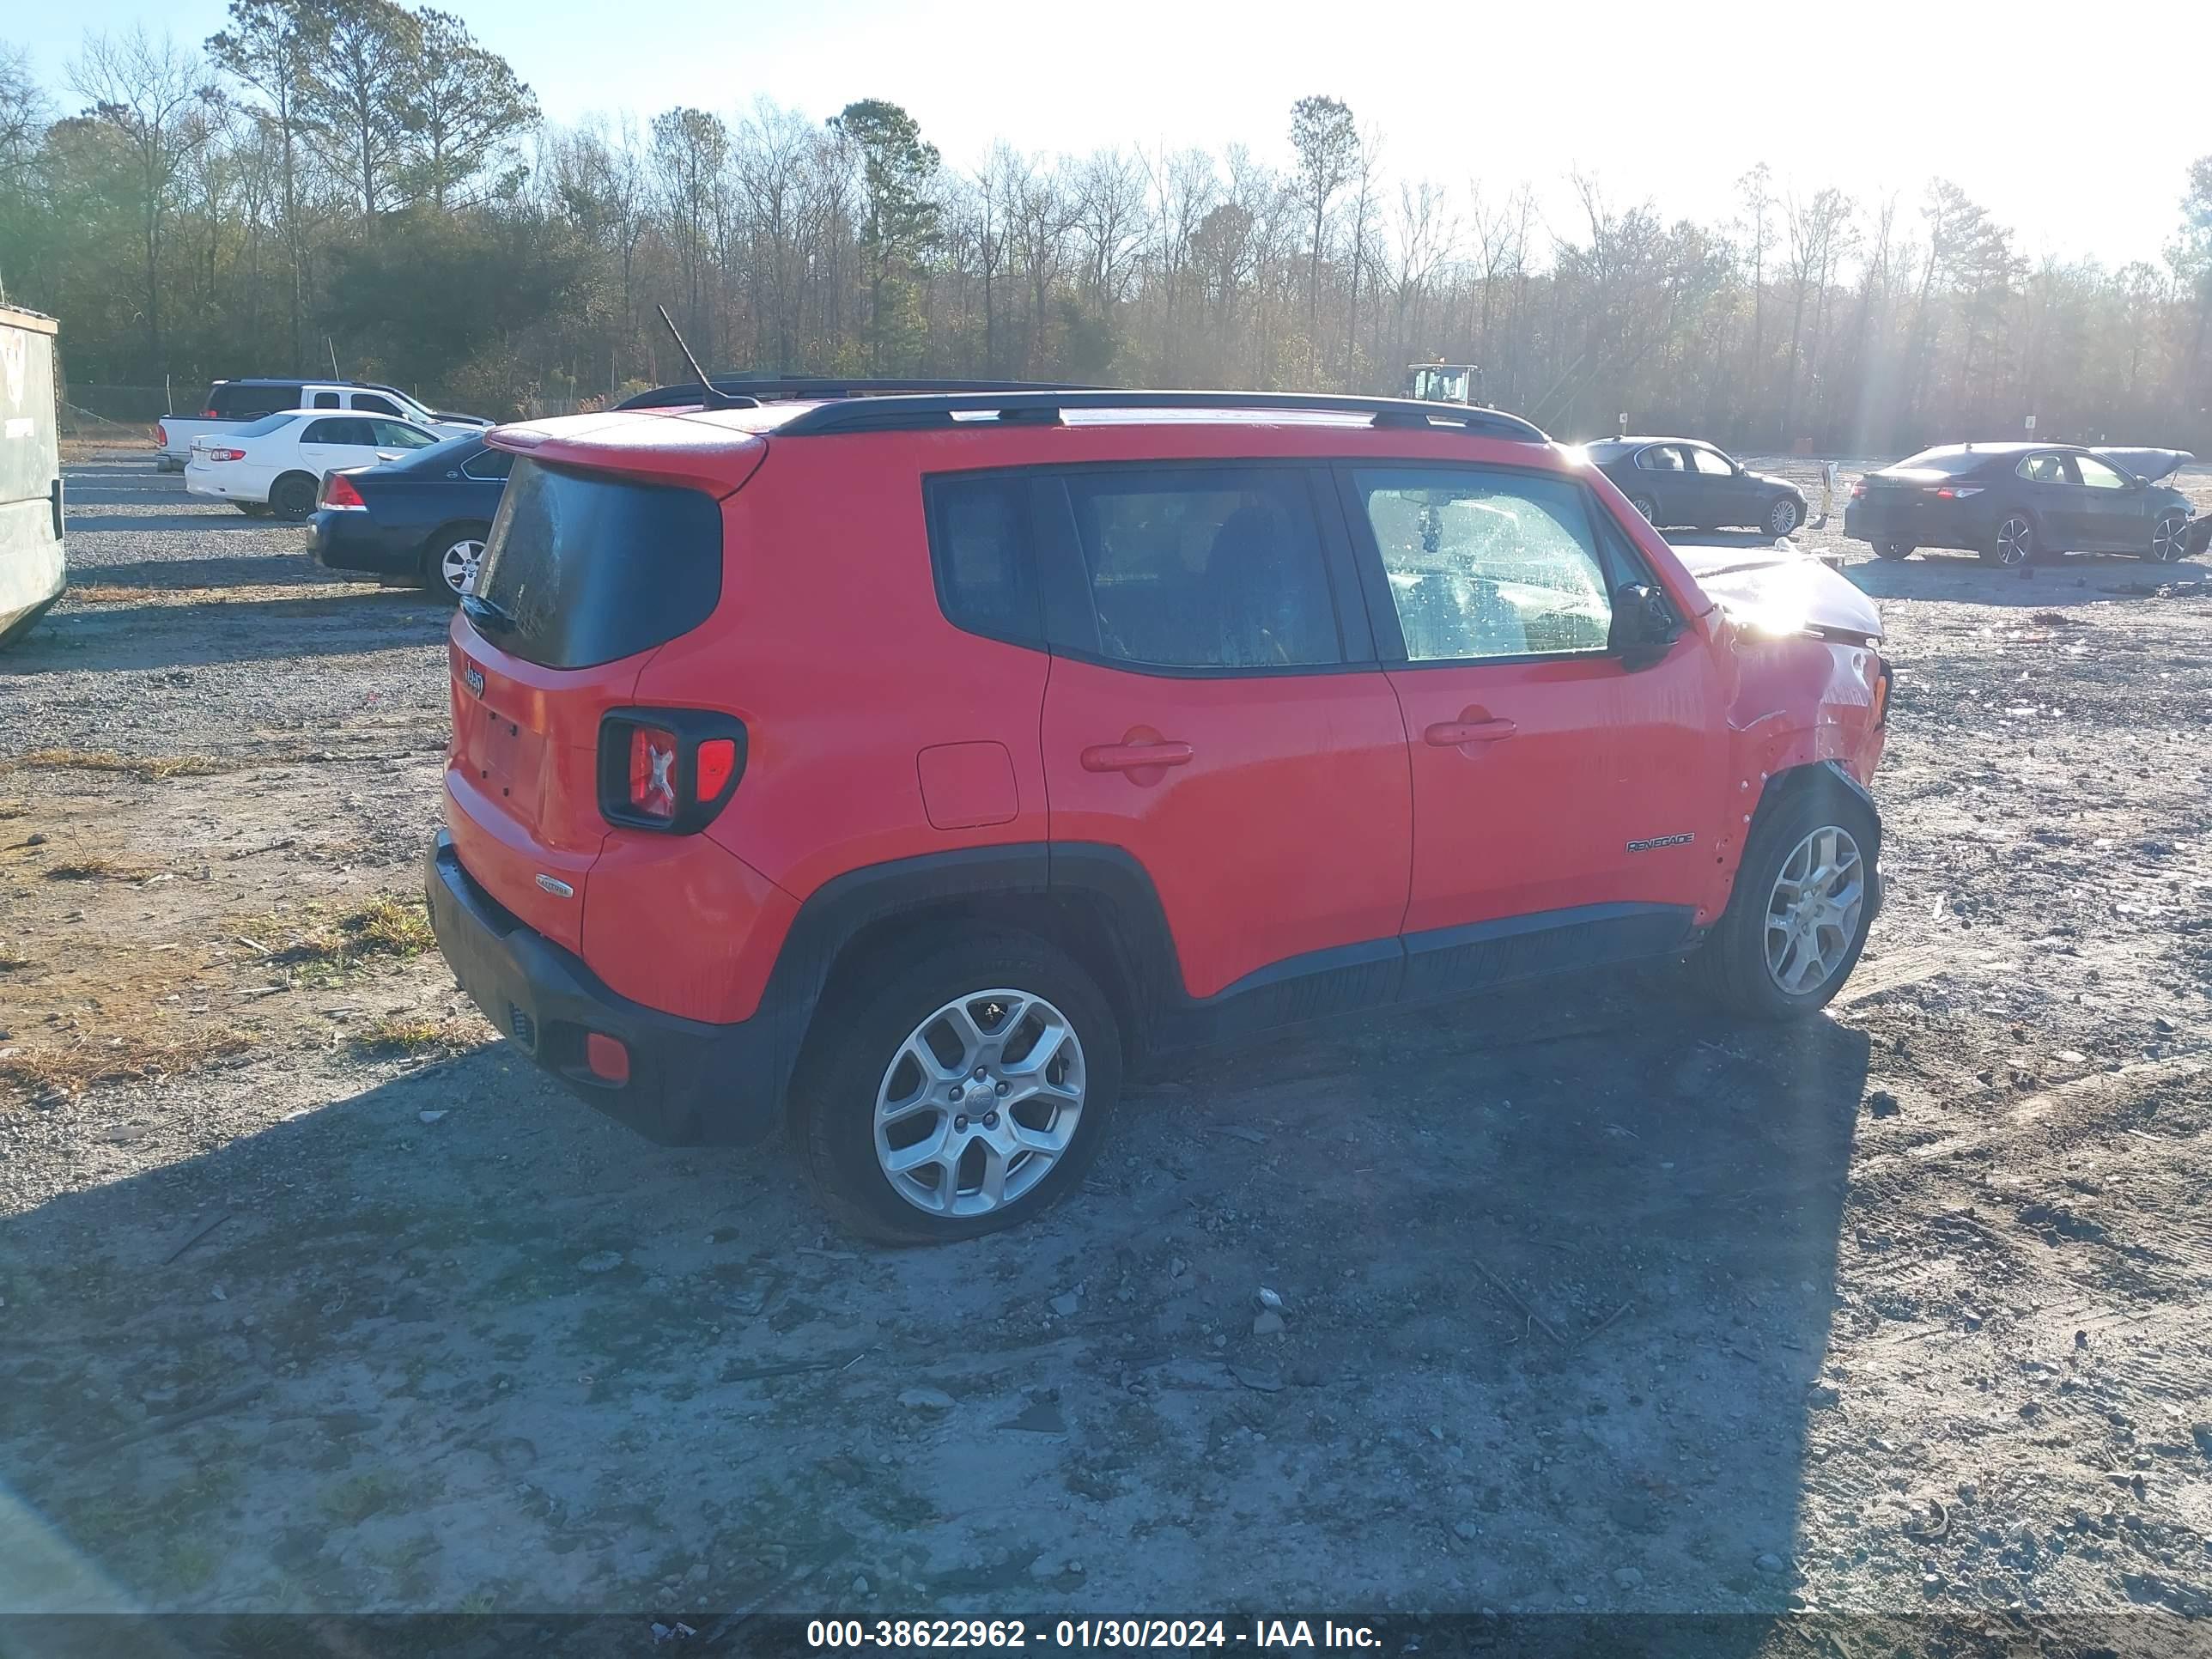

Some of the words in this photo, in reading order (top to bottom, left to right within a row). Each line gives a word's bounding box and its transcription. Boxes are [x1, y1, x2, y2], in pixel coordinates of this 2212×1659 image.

[464, 660, 484, 701] Jeep
[1626, 832, 1695, 853] RENEGADE
[537, 877, 568, 895] LATITUDE
